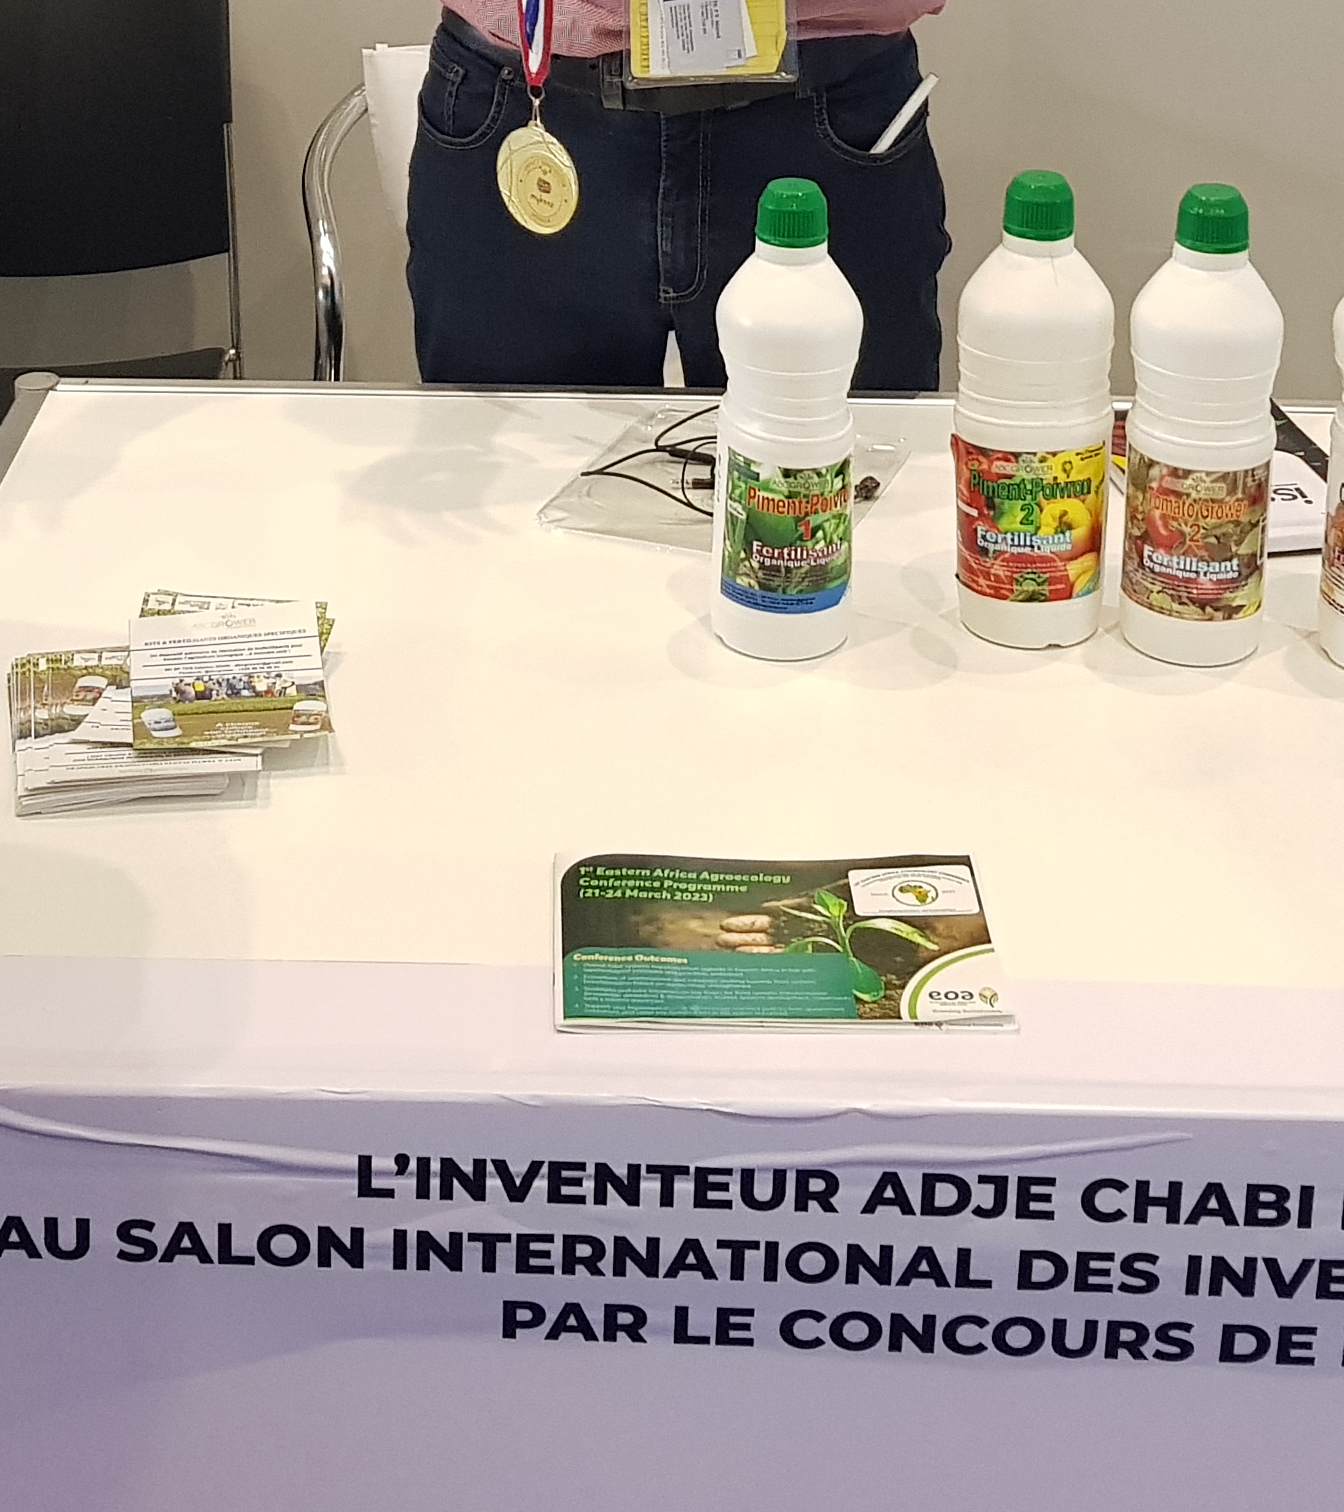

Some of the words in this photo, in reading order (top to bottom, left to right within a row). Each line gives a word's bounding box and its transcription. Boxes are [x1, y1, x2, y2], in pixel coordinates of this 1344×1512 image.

[1020, 504, 1034, 525] 2
[798, 519, 811, 540] 1
[977, 526, 1071, 545] Fertilisant
[1188, 523, 1202, 543] 2
[752, 540, 842, 560] Fertilisant
[1143, 544, 1239, 572] Fertilisant
[579, 877, 660, 888] Conference
[663, 879, 748, 892] Programme
[596, 867, 650, 877] Eastern
[654, 868, 697, 879] Africa
[699, 871, 791, 884] Agroecology
[625, 889, 671, 900] March
[635, 954, 688, 964] Outcomes
[357, 1154, 840, 1214] L'INVENTEUR
[860, 1171, 1056, 1220] ADJE
[1081, 1178, 1312, 1230] CHABI
[115, 1218, 364, 1269] SALON
[392, 1229, 991, 1288] INTERNATIONAL
[1016, 1249, 1161, 1294] DES
[502, 1299, 648, 1342] PAR
[673, 1306, 755, 1347] LE
[778, 1308, 1194, 1361] CONCOURS
[1218, 1323, 1317, 1367] DE
